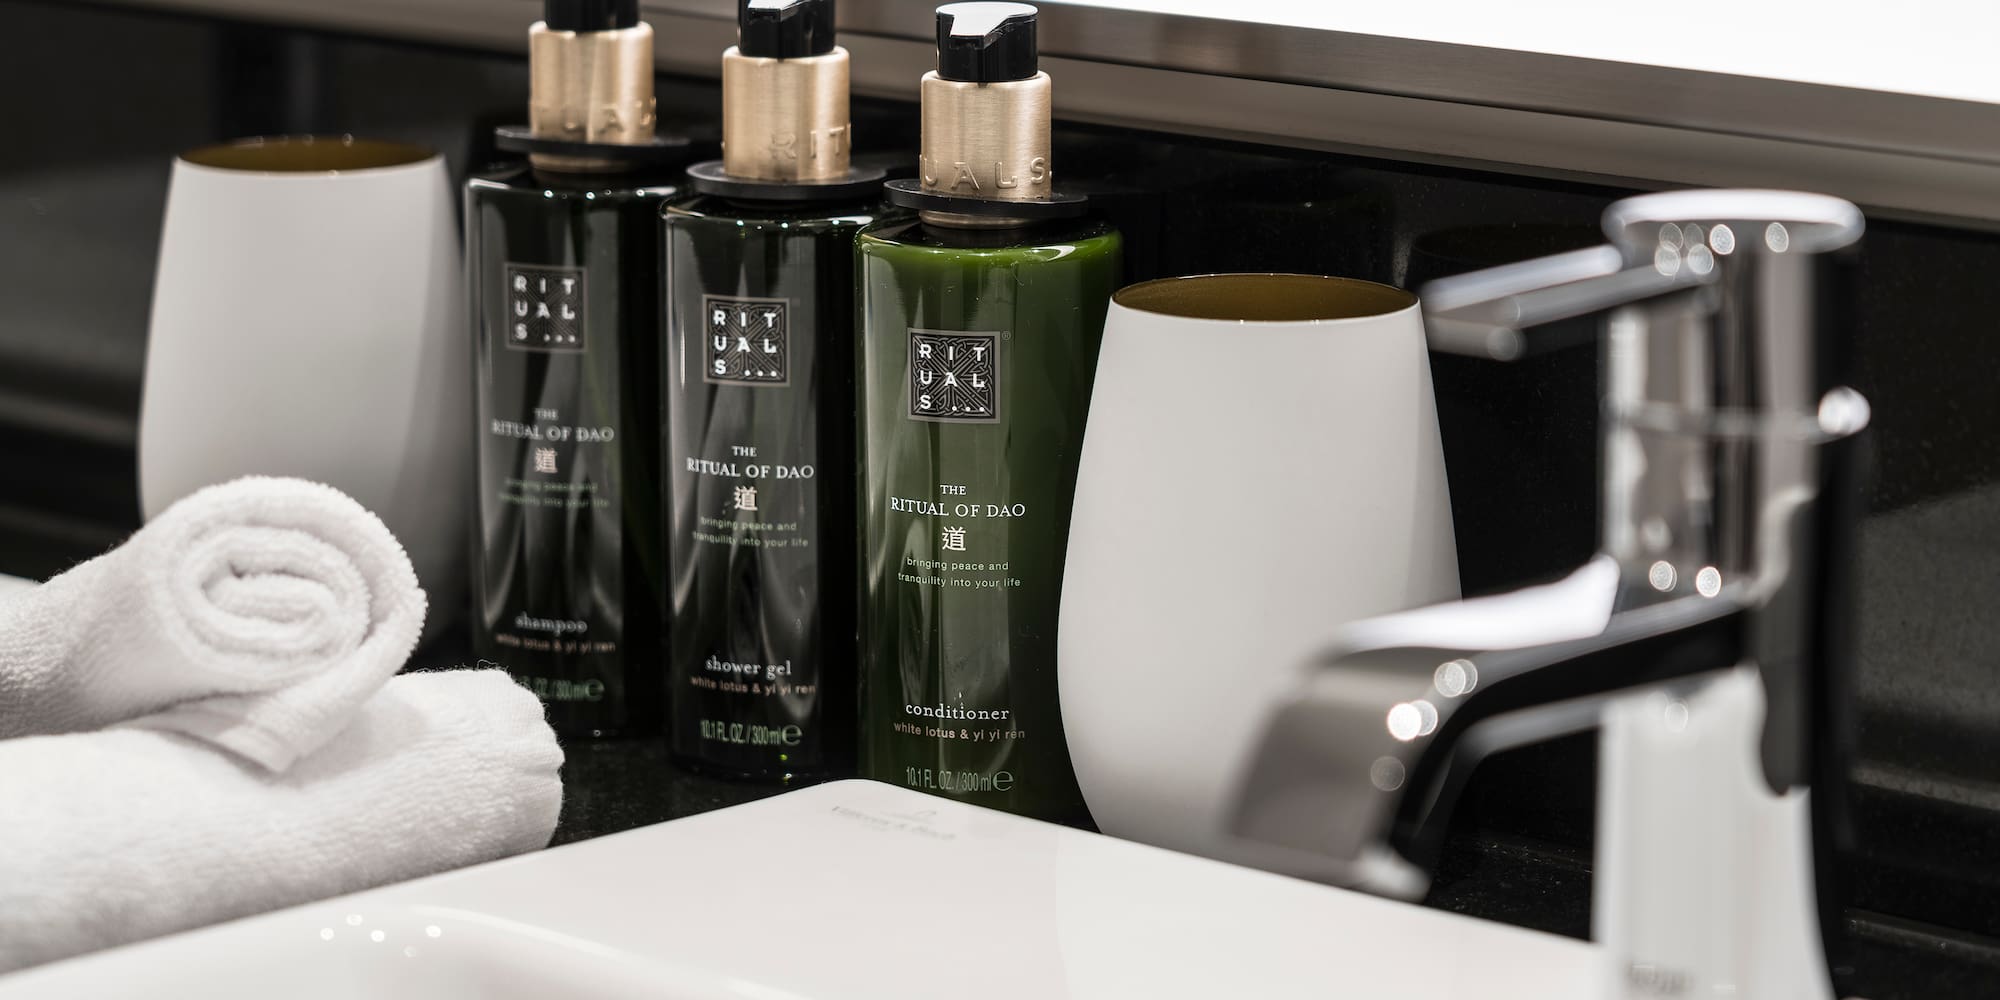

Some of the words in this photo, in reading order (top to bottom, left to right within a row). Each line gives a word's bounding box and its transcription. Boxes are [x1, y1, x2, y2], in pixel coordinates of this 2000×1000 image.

[919, 343, 985, 361] RIT
[920, 370, 985, 388] UAL
[535, 407, 559, 420] THE
[491, 419, 543, 440] RITUAL
[546, 425, 572, 442] OF
[576, 426, 615, 442] DAO
[535, 447, 558, 473] 道
[731, 445, 758, 457] THE
[685, 457, 741, 478] RITUAL
[745, 464, 771, 479] OF
[776, 464, 815, 479] DAO
[733, 485, 758, 511] 道
[940, 484, 967, 496] THE
[890, 496, 950, 517] RITUAL
[955, 503, 981, 518] OF
[987, 503, 1026, 518] DAO
[700, 516, 738, 532] bringing
[741, 521, 773, 532] peace
[776, 521, 797, 531] and
[693, 531, 738, 546] tranquility
[764, 539, 787, 549] your
[790, 537, 809, 547] life
[941, 526, 967, 552] 道
[906, 557, 948, 572] bringing
[951, 563, 985, 572] peace
[988, 561, 1009, 571] and
[898, 572, 947, 588] tranquility
[950, 577, 971, 587] into
[975, 579, 1000, 590] your
[1003, 577, 1021, 587] life
[514, 611, 588, 636] shampoo
[705, 654, 762, 675] shower
[766, 660, 792, 681] gel
[690, 676, 717, 690] white
[720, 680, 748, 693] lotus
[752, 682, 761, 693] &
[764, 684, 776, 697] yi
[781, 684, 792, 697] yi
[794, 684, 816, 695] ren
[905, 702, 1010, 720] conditioner
[893, 722, 922, 736] white
[925, 726, 956, 739] lotus
[960, 728, 969, 740] &
[973, 729, 984, 743] yi
[989, 729, 1000, 743] yi
[1005, 729, 1025, 740] ren
[906, 766, 922, 787] 10.1
